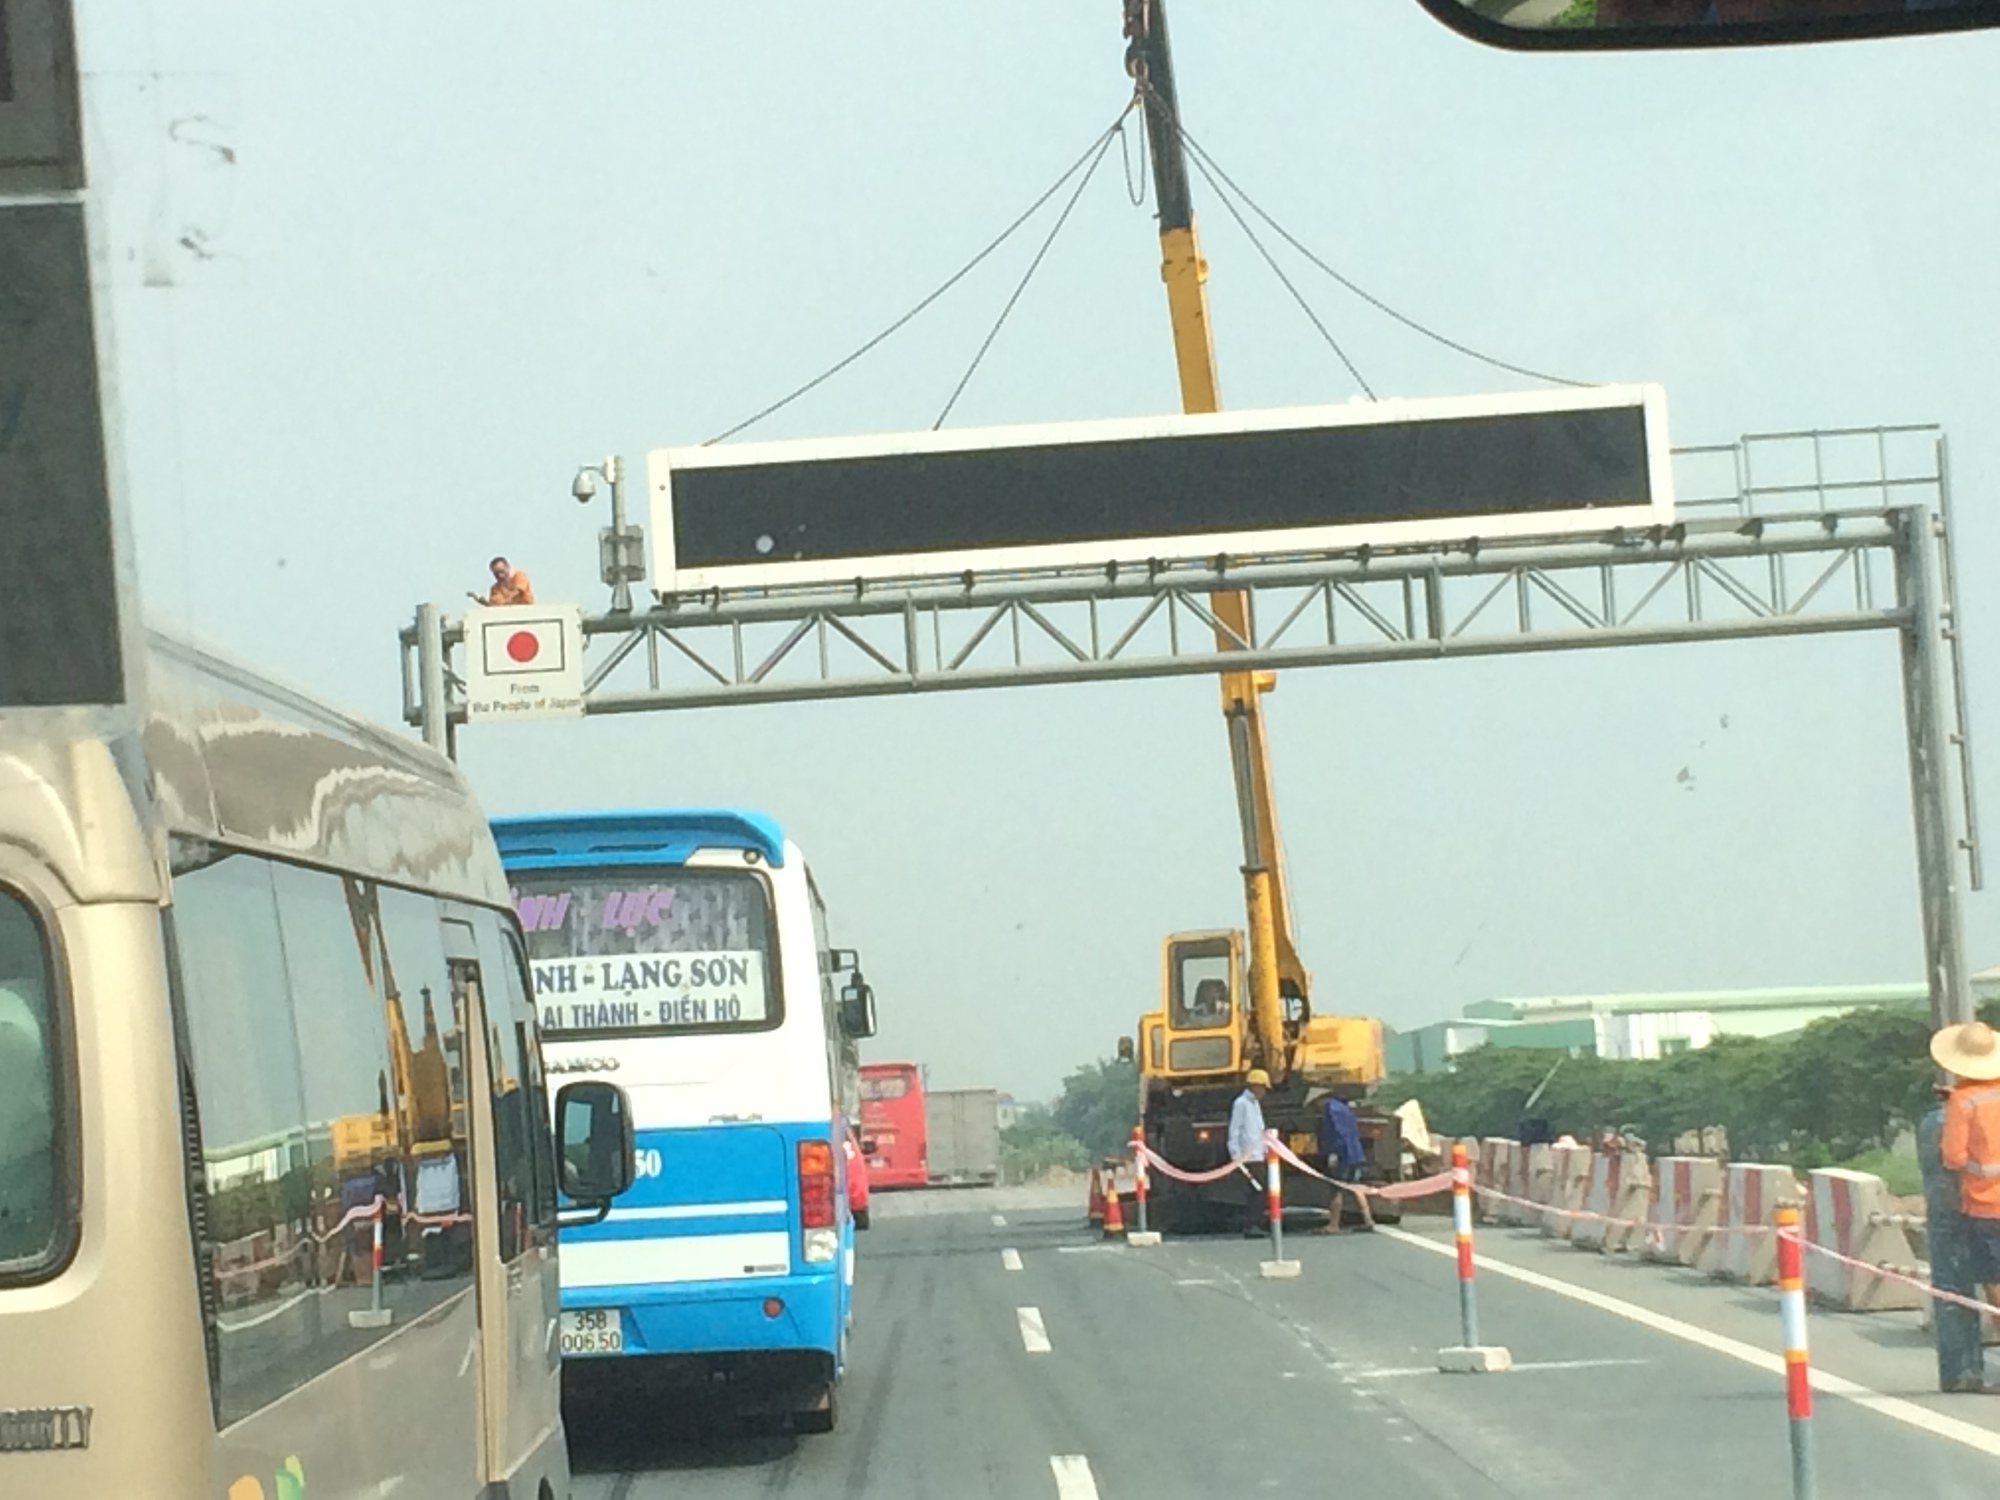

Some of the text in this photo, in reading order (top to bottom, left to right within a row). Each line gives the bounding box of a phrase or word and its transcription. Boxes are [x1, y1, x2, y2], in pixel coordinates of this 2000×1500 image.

[510, 683, 540, 695] From
[473, 698, 581, 713] the People of Japan
[601, 960, 682, 997] LẠNG
[690, 954, 749, 988] SƠN
